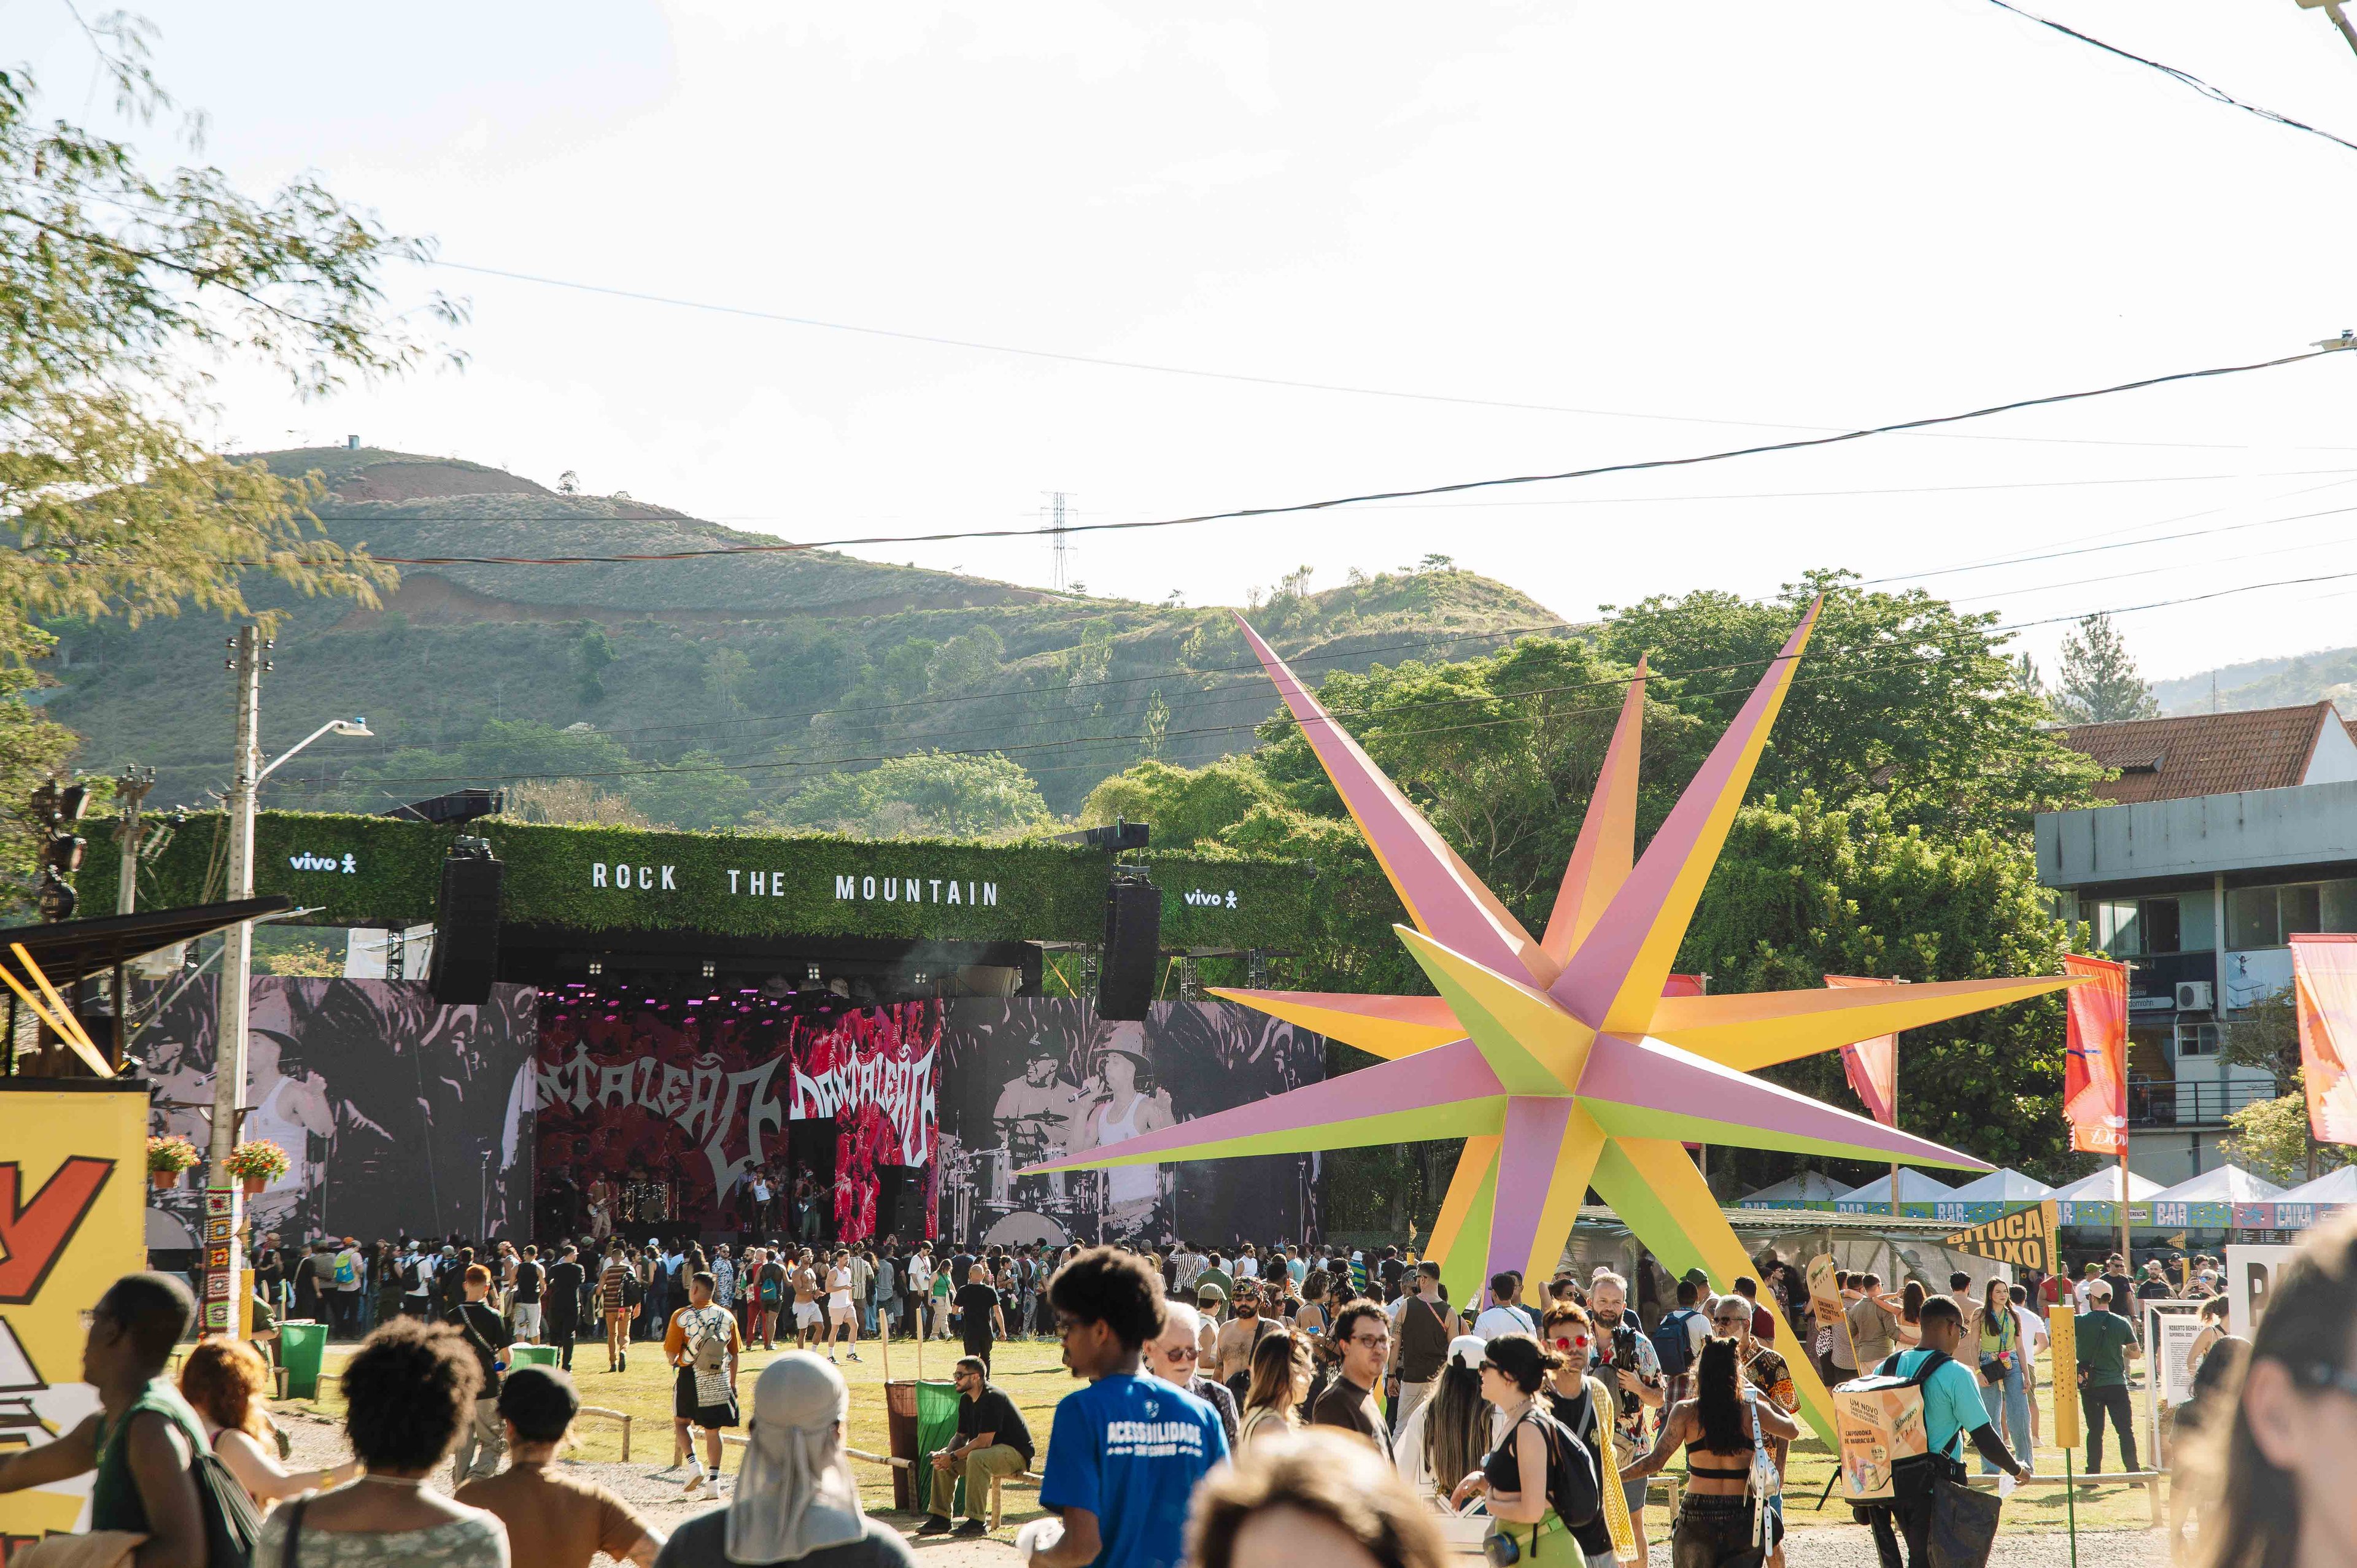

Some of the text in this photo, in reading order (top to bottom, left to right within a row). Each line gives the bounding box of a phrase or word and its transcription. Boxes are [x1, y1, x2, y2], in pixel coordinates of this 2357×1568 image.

[289, 852, 337, 870] vivo
[593, 863, 997, 906] ROCK THE MOUNTAIN
[1185, 889, 1221, 905] vivo
[1938, 1203, 1964, 1221] BAR
[2057, 1202, 2072, 1224] AR
[2157, 1203, 2187, 1226] BAR
[2277, 1204, 2312, 1227] CAIXA
[1947, 1209, 2043, 1245] BITUCA
[1978, 1240, 2042, 1269] LIXO
[1817, 1300, 1834, 1310] DRINKS
[1819, 1307, 1840, 1318] PRONTOS
[1849, 1397, 1878, 1415] UM NOVO
